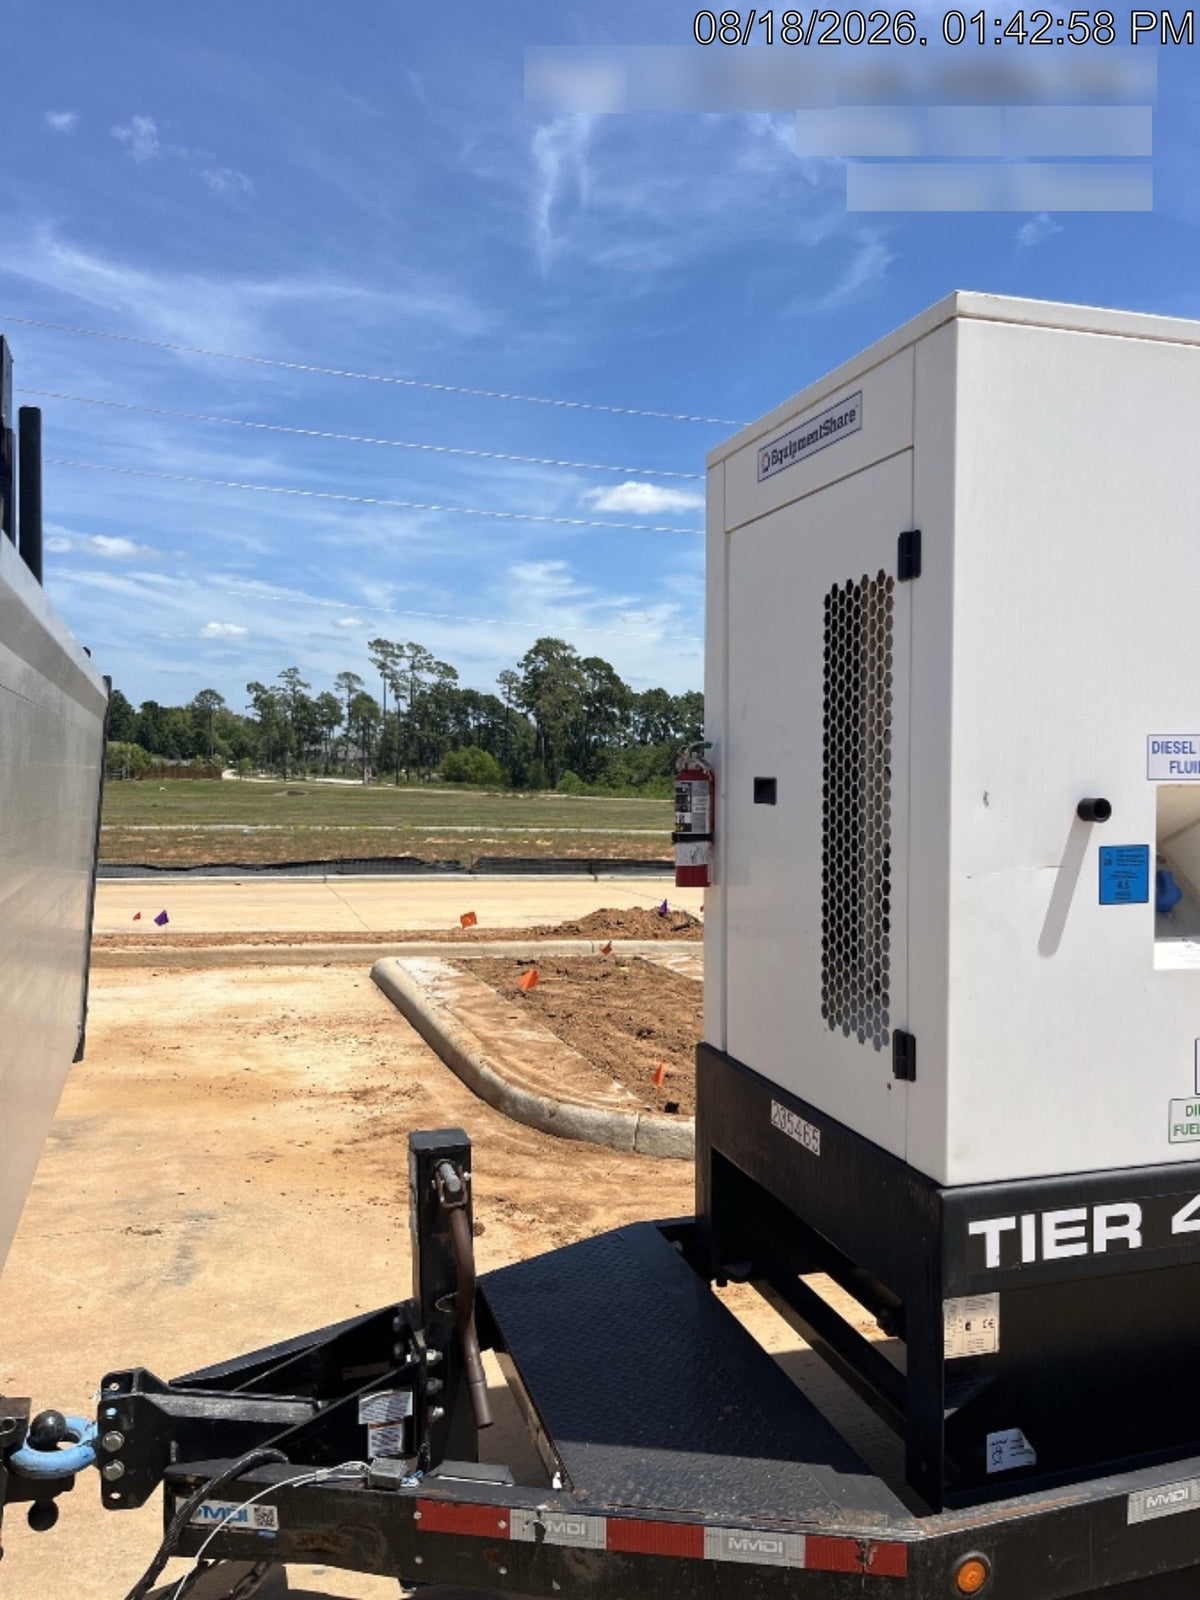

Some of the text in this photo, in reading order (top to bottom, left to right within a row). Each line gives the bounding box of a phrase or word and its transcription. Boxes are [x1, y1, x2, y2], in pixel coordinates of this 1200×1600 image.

[771, 409, 857, 467] EquipmentShare
[1151, 740, 1197, 755] DIESEL
[968, 1202, 1142, 1269] TIER
